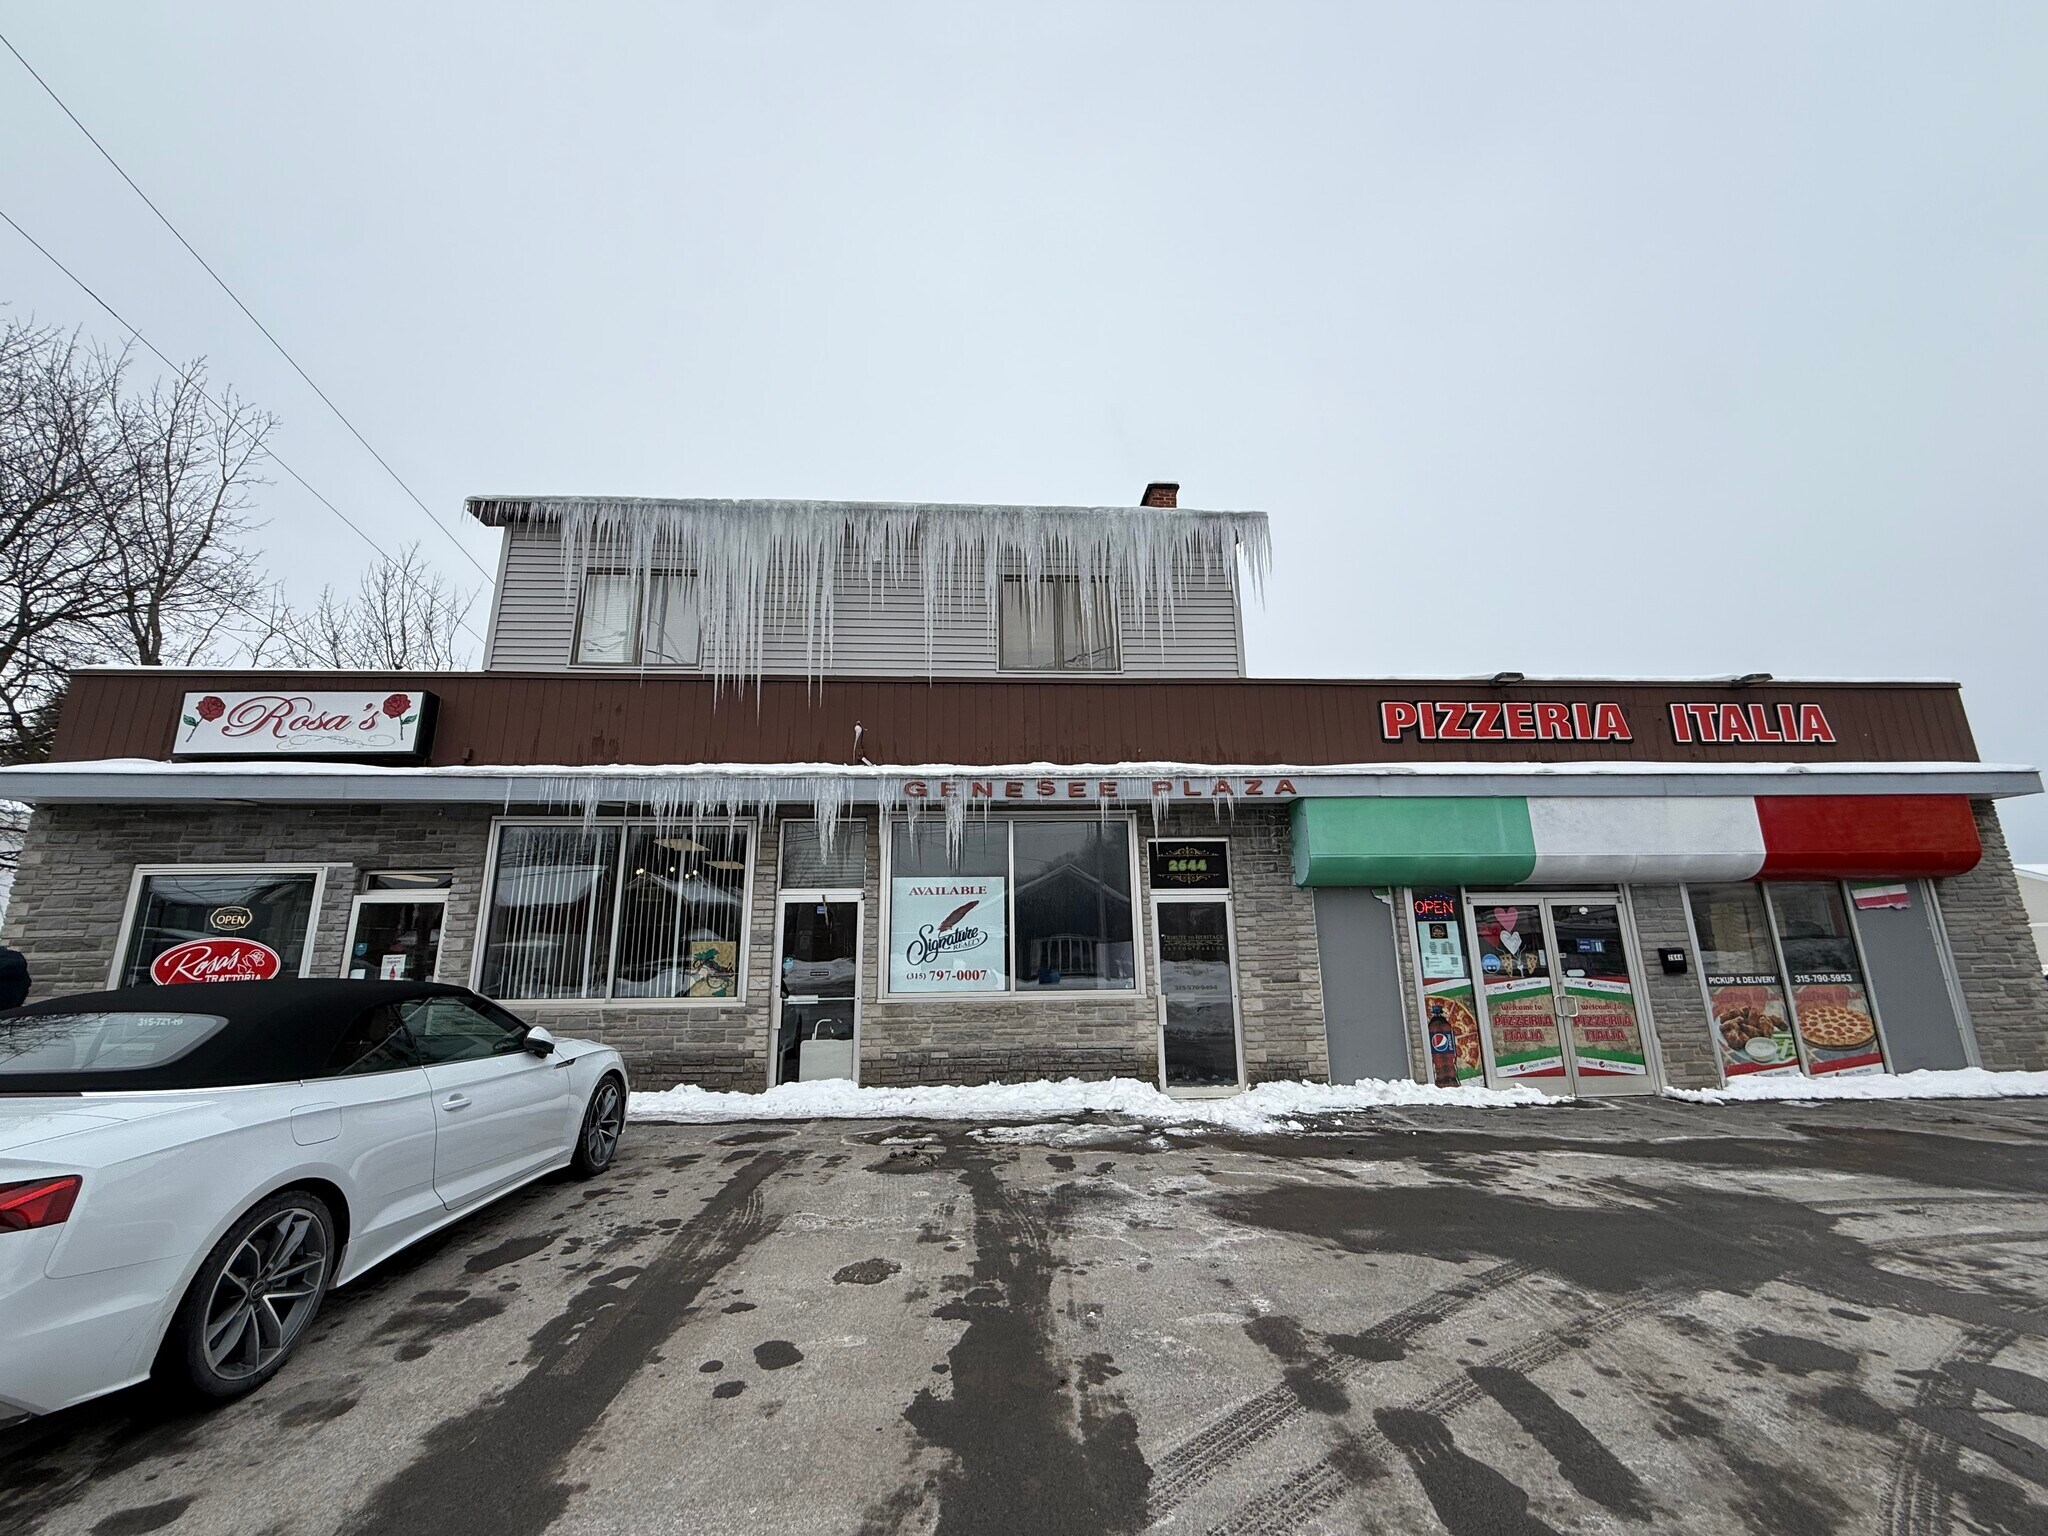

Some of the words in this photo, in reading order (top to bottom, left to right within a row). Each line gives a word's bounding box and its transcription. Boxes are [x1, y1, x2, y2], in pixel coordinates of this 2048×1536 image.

[222, 696, 380, 738] Rosa's
[1381, 702, 1633, 741] PIZZERIA
[1670, 703, 1838, 743] ITALIA
[904, 781, 1118, 798] GENESEE
[1152, 780, 1297, 796] PLAZA
[1168, 859, 1207, 872] 2644
[908, 886, 987, 896] AVAILABLE
[1414, 900, 1454, 914] OPEN
[216, 915, 246, 925] OPEN
[907, 924, 980, 966] Signature
[953, 938, 980, 950] REALTY
[164, 946, 240, 985] Rosa's
[907, 972, 926, 980] (315)
[929, 970, 987, 981] 797-0007
[1708, 976, 1734, 984] PICKUP
[1744, 975, 1775, 984] DELIVERY
[1795, 974, 1853, 983] 315-790-5953
[1493, 1014, 1554, 1028] PIZZERIA
[1572, 1014, 1634, 1028] PIZZERIA
[1503, 1029, 1545, 1042] ITALIA
[1585, 1029, 1627, 1042] ITALIA
